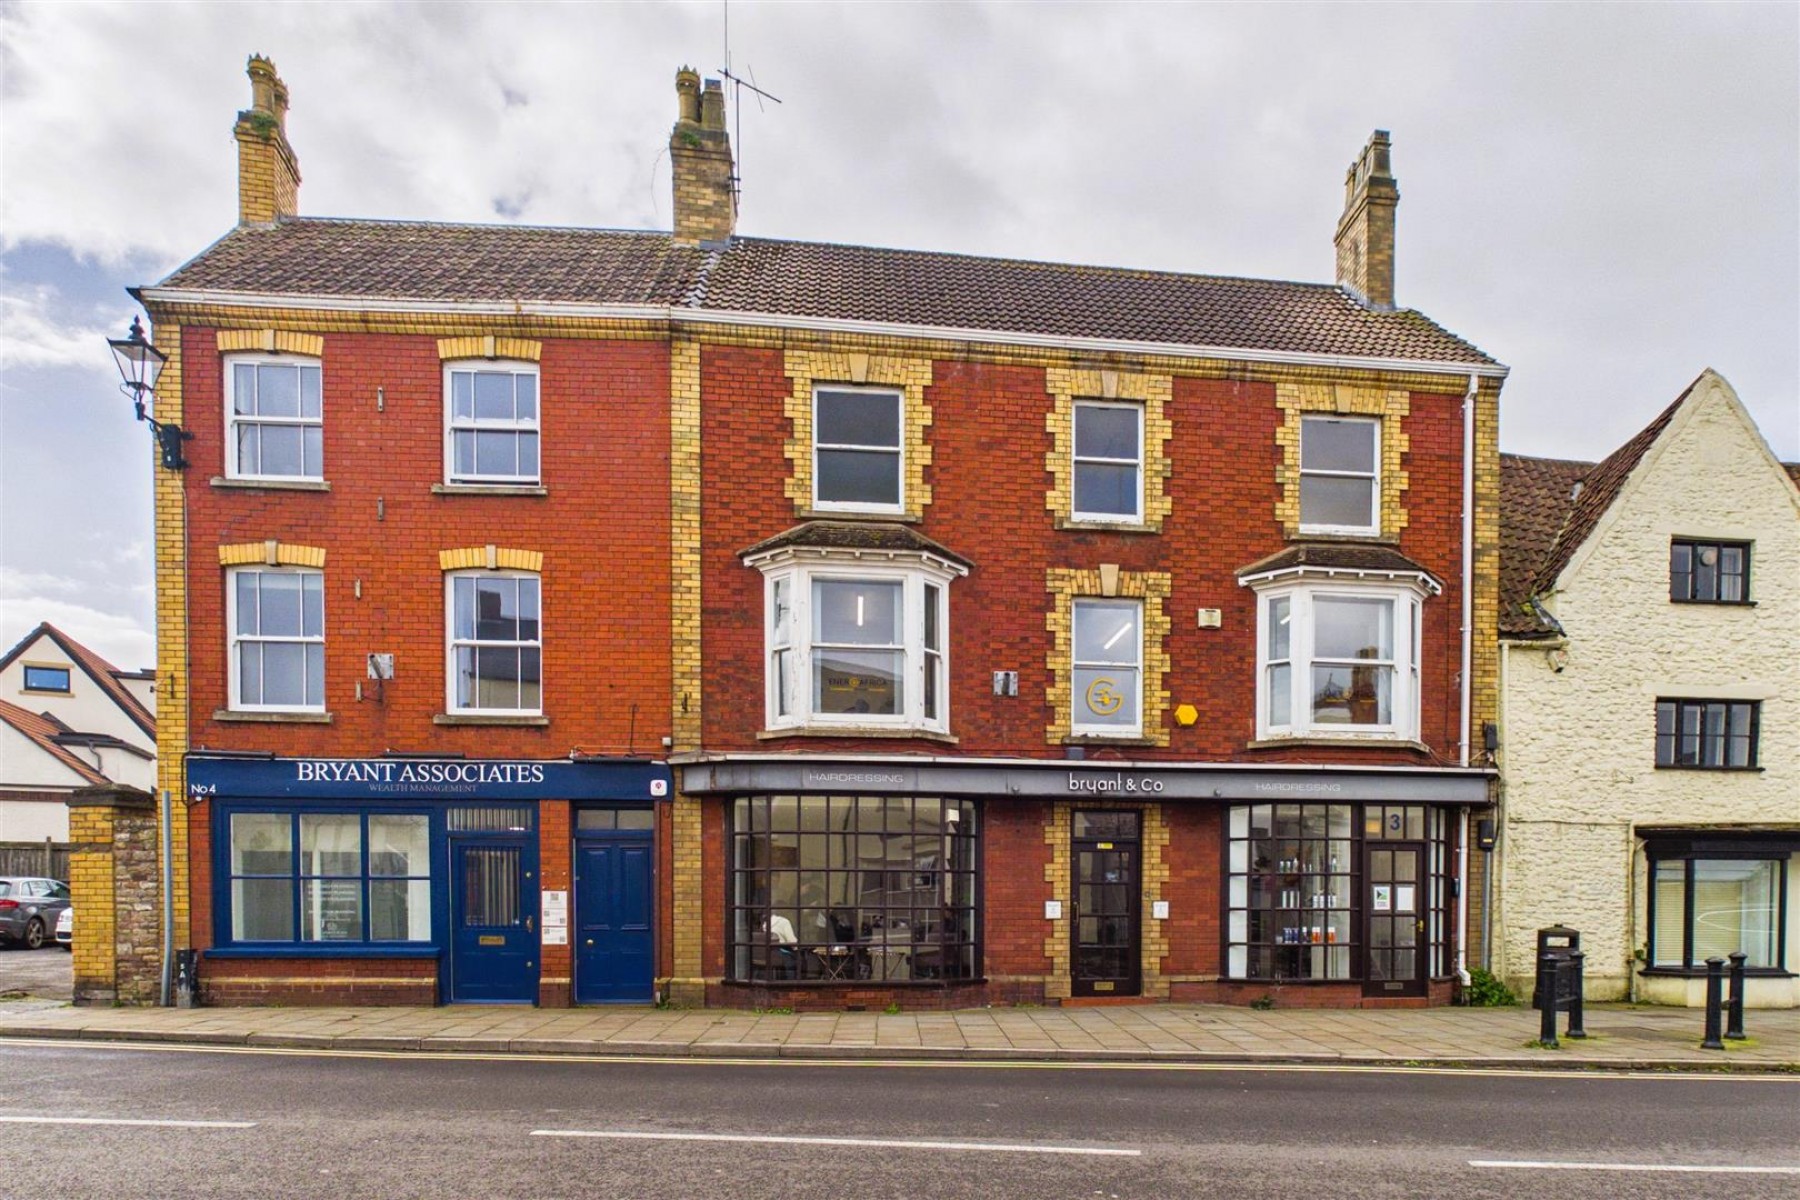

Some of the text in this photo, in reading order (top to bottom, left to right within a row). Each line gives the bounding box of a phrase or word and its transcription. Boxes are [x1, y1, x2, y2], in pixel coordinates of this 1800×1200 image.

[297, 762, 544, 783] BRYANT ASSOCIATES
[809, 773, 904, 783] HAIRDRESSING
[369, 783, 477, 793] WEALTH MANAGEMENT
[1069, 772, 1163, 794] bryant & Co
[1255, 782, 1341, 792] HAIRDRESSING
[1390, 814, 1400, 831] 3
